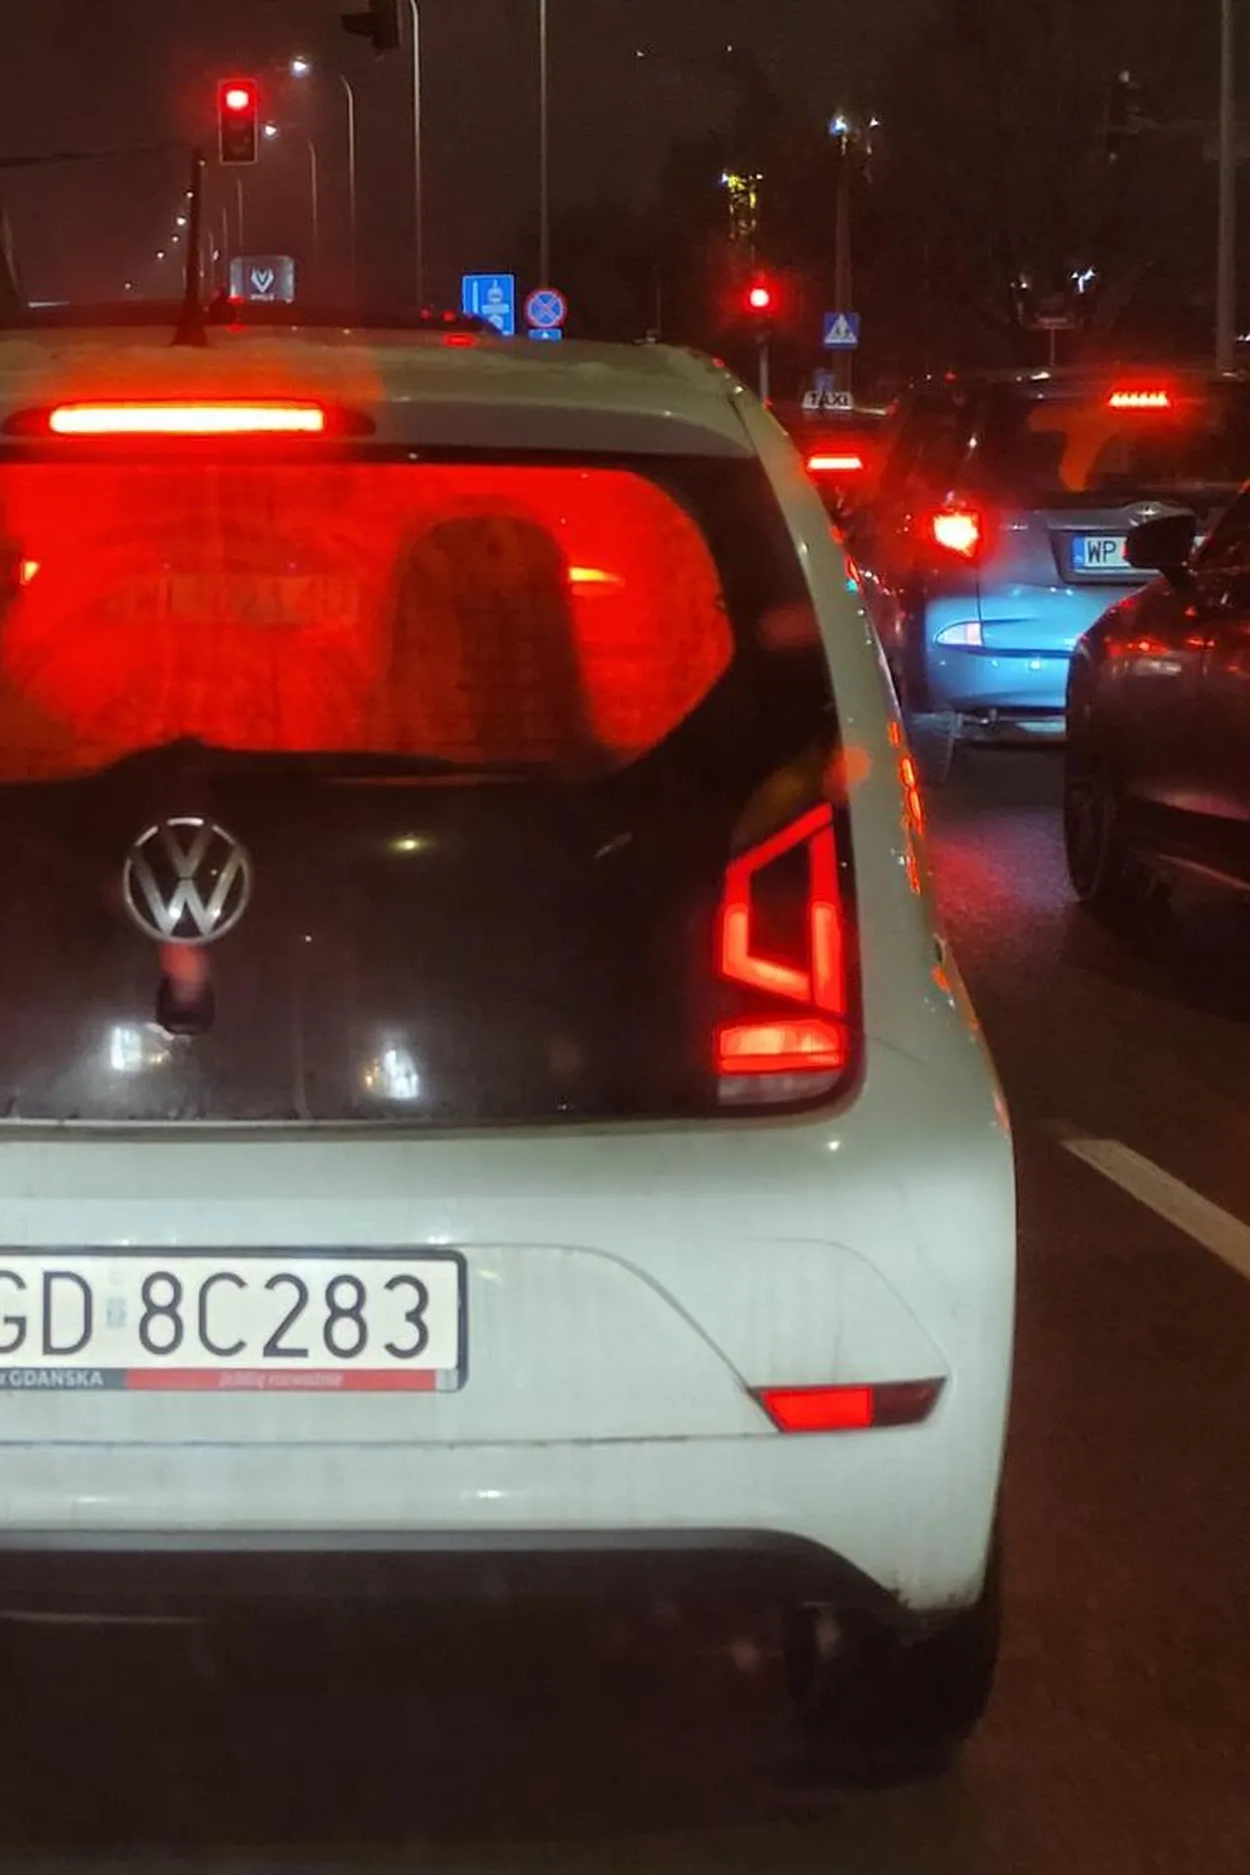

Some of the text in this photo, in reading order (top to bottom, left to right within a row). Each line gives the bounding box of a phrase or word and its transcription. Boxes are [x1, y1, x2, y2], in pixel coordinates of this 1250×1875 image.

[810, 391, 849, 406] TAXI
[1086, 540, 1117, 563] WP
[139, 1271, 429, 1360] 8C283
